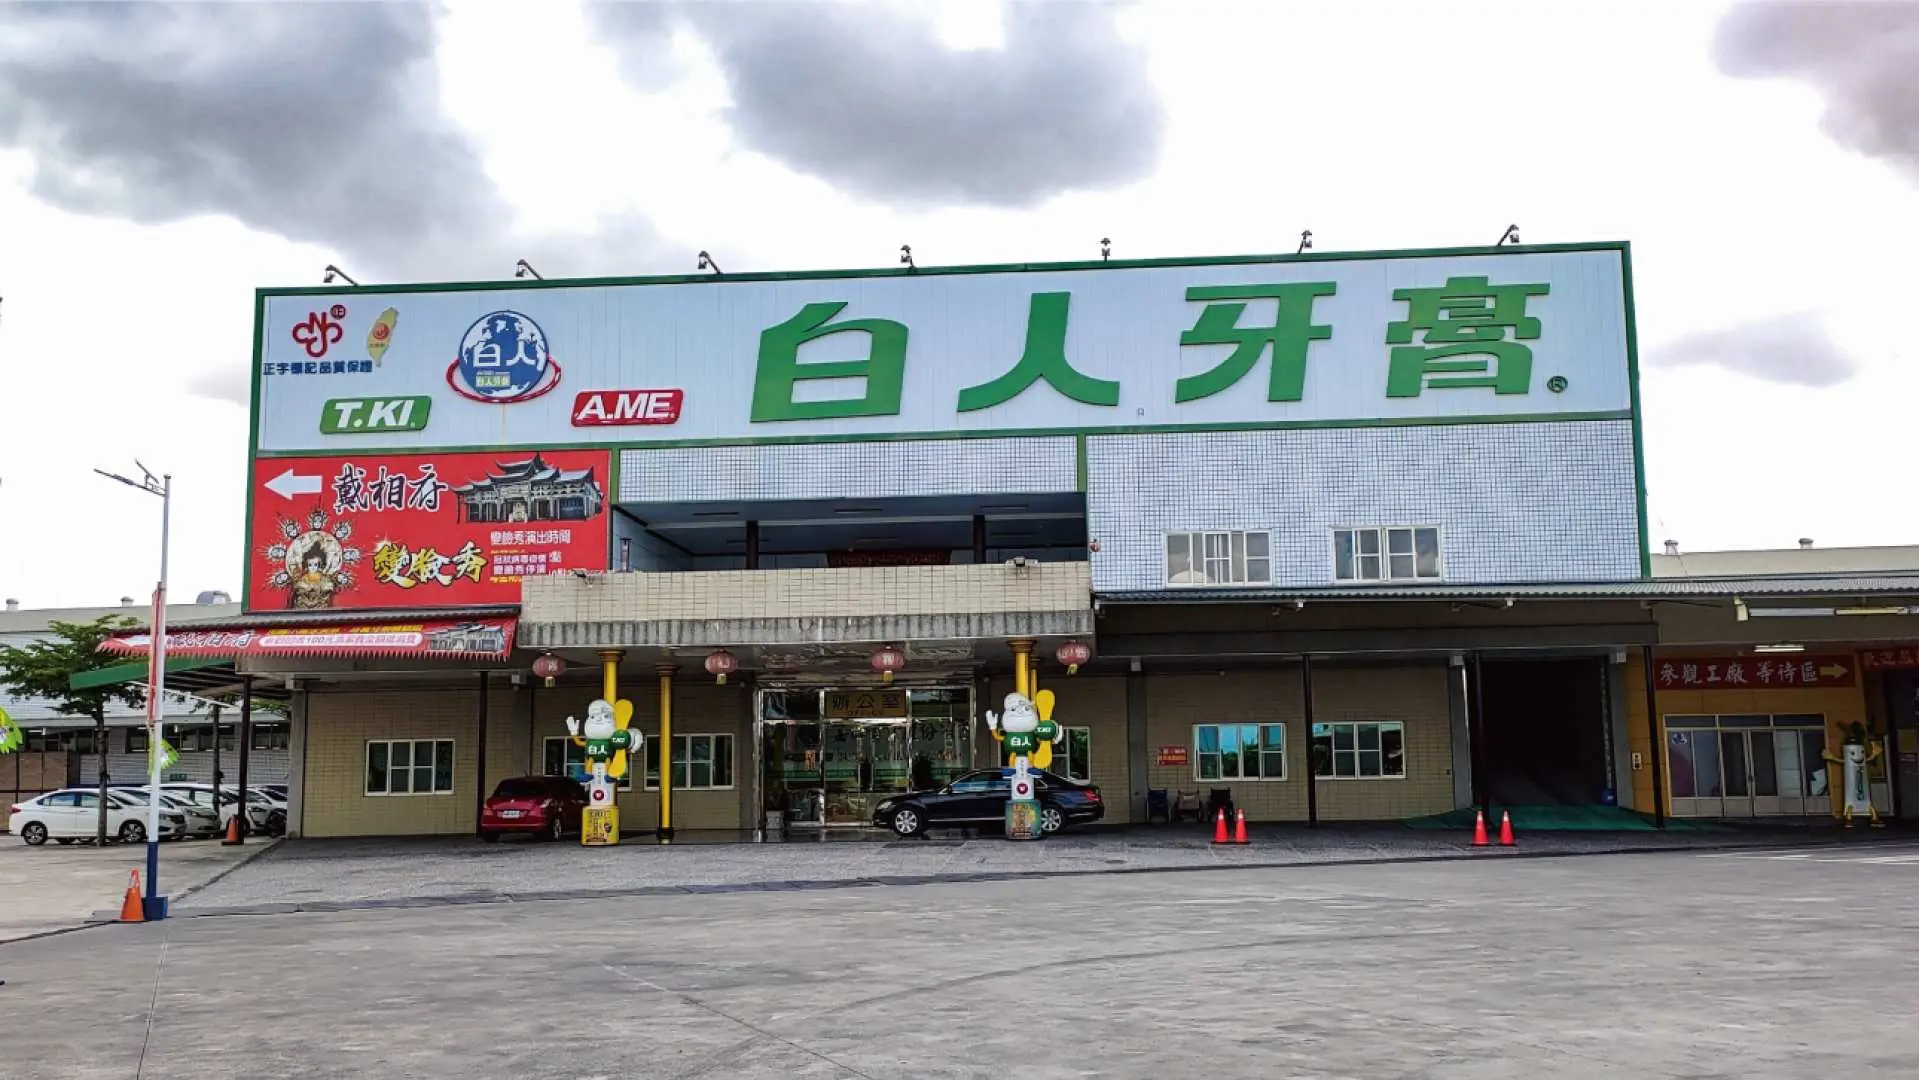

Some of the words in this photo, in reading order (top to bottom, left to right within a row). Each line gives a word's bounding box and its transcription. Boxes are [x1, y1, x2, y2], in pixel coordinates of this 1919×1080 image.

[473, 341, 536, 367] 白人
[750, 276, 1550, 423] 白人牙膏
[332, 463, 448, 515] 戴相府
[1660, 661, 1748, 686] 參觀工廠
[1756, 660, 1818, 684] 等待區
